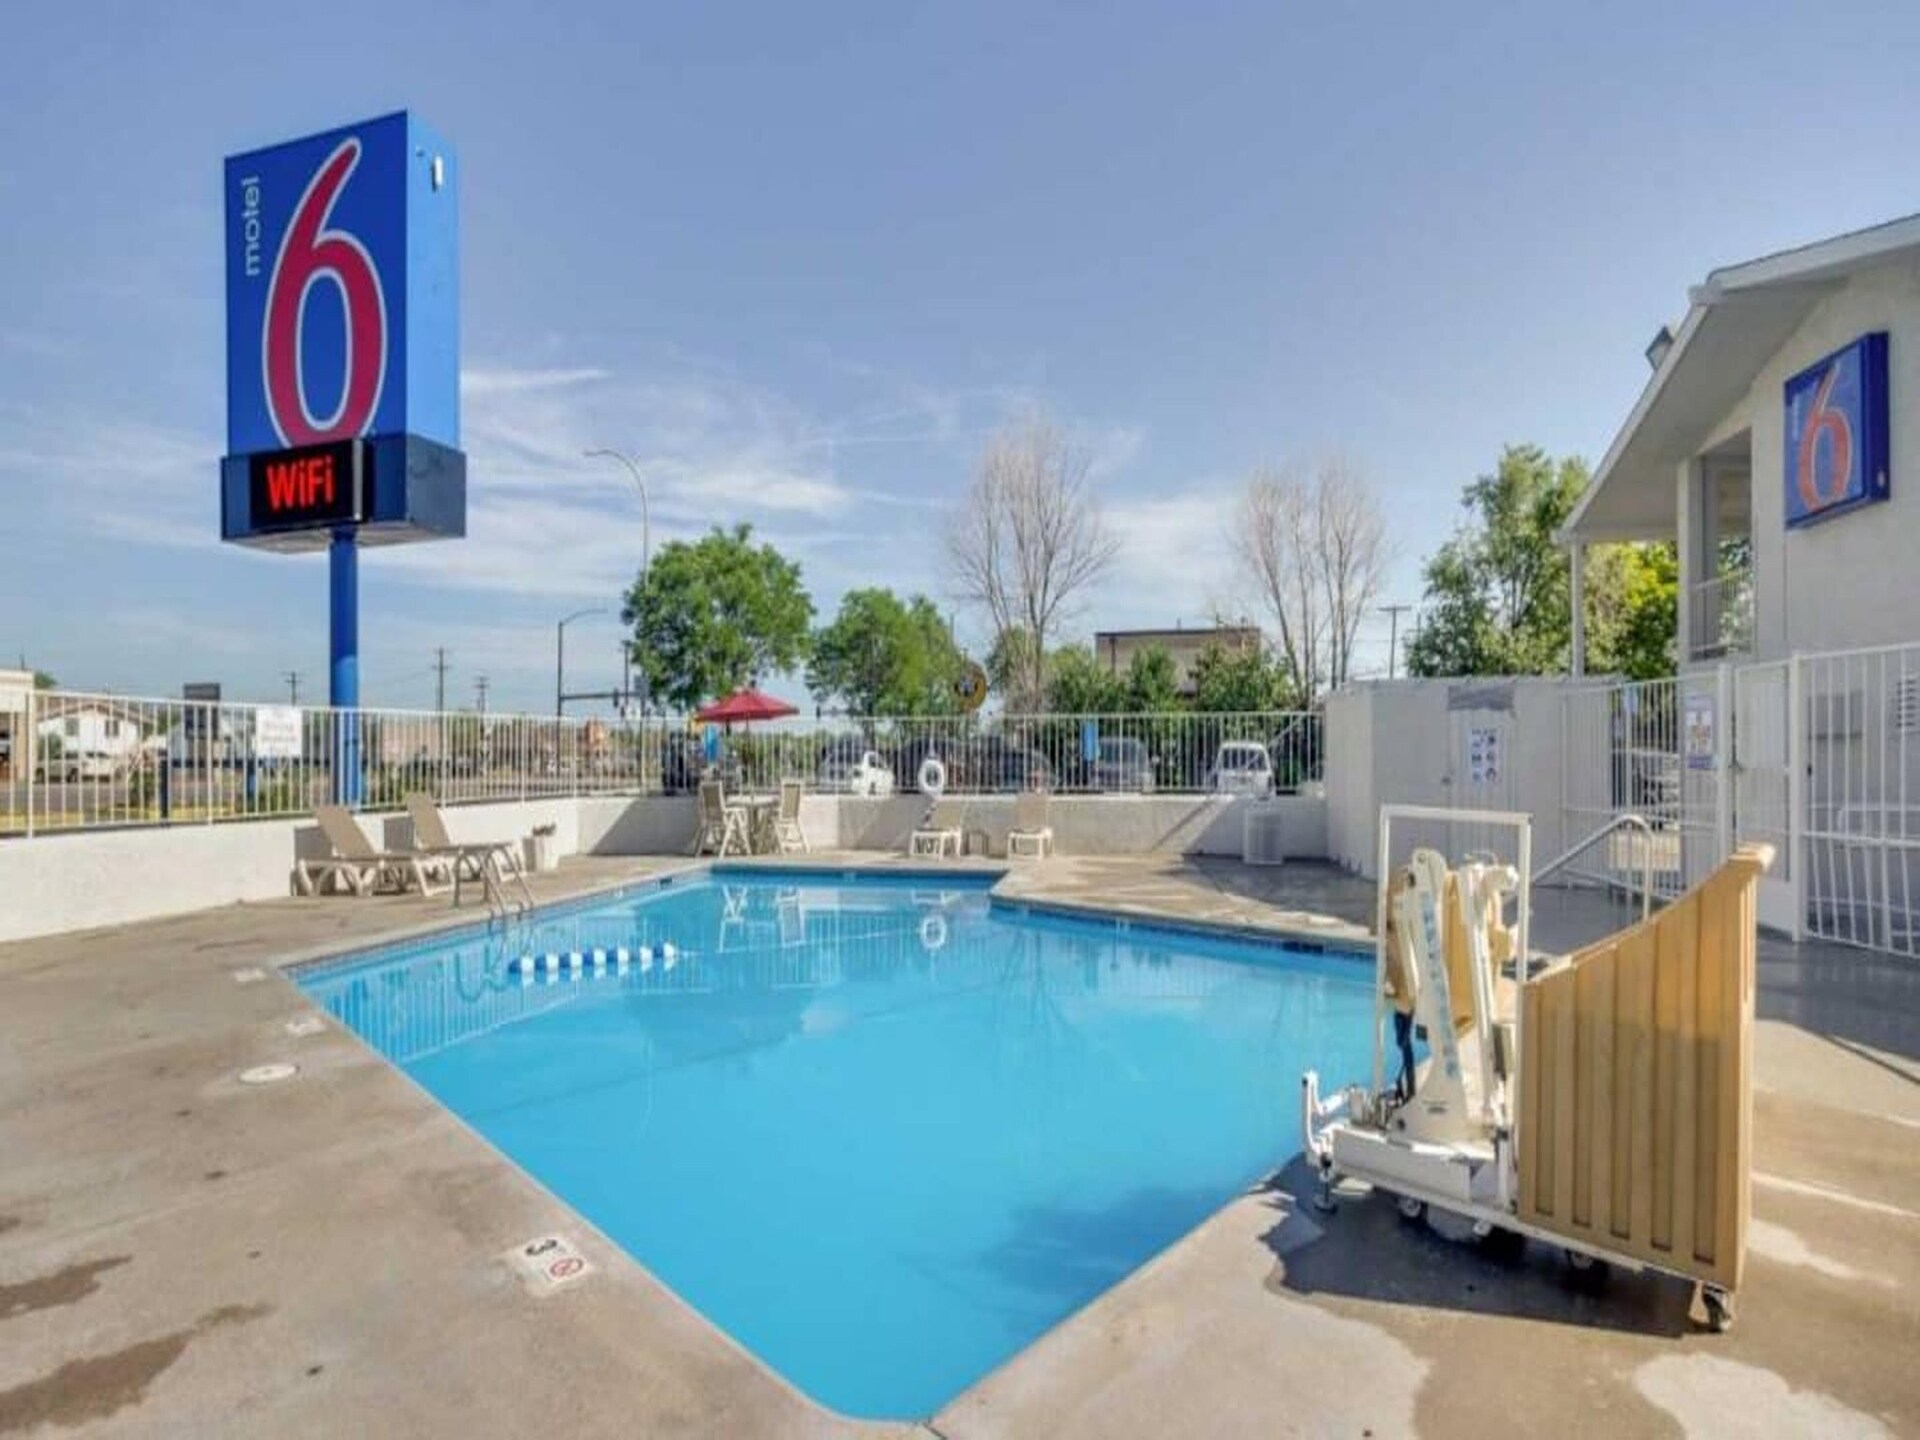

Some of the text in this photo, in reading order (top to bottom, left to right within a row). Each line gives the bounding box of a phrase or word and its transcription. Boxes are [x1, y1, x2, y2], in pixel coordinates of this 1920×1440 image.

[241, 175, 261, 276] motel
[262, 136, 388, 448] 6
[266, 454, 333, 510] WiFi
[1797, 358, 1854, 513] 6
